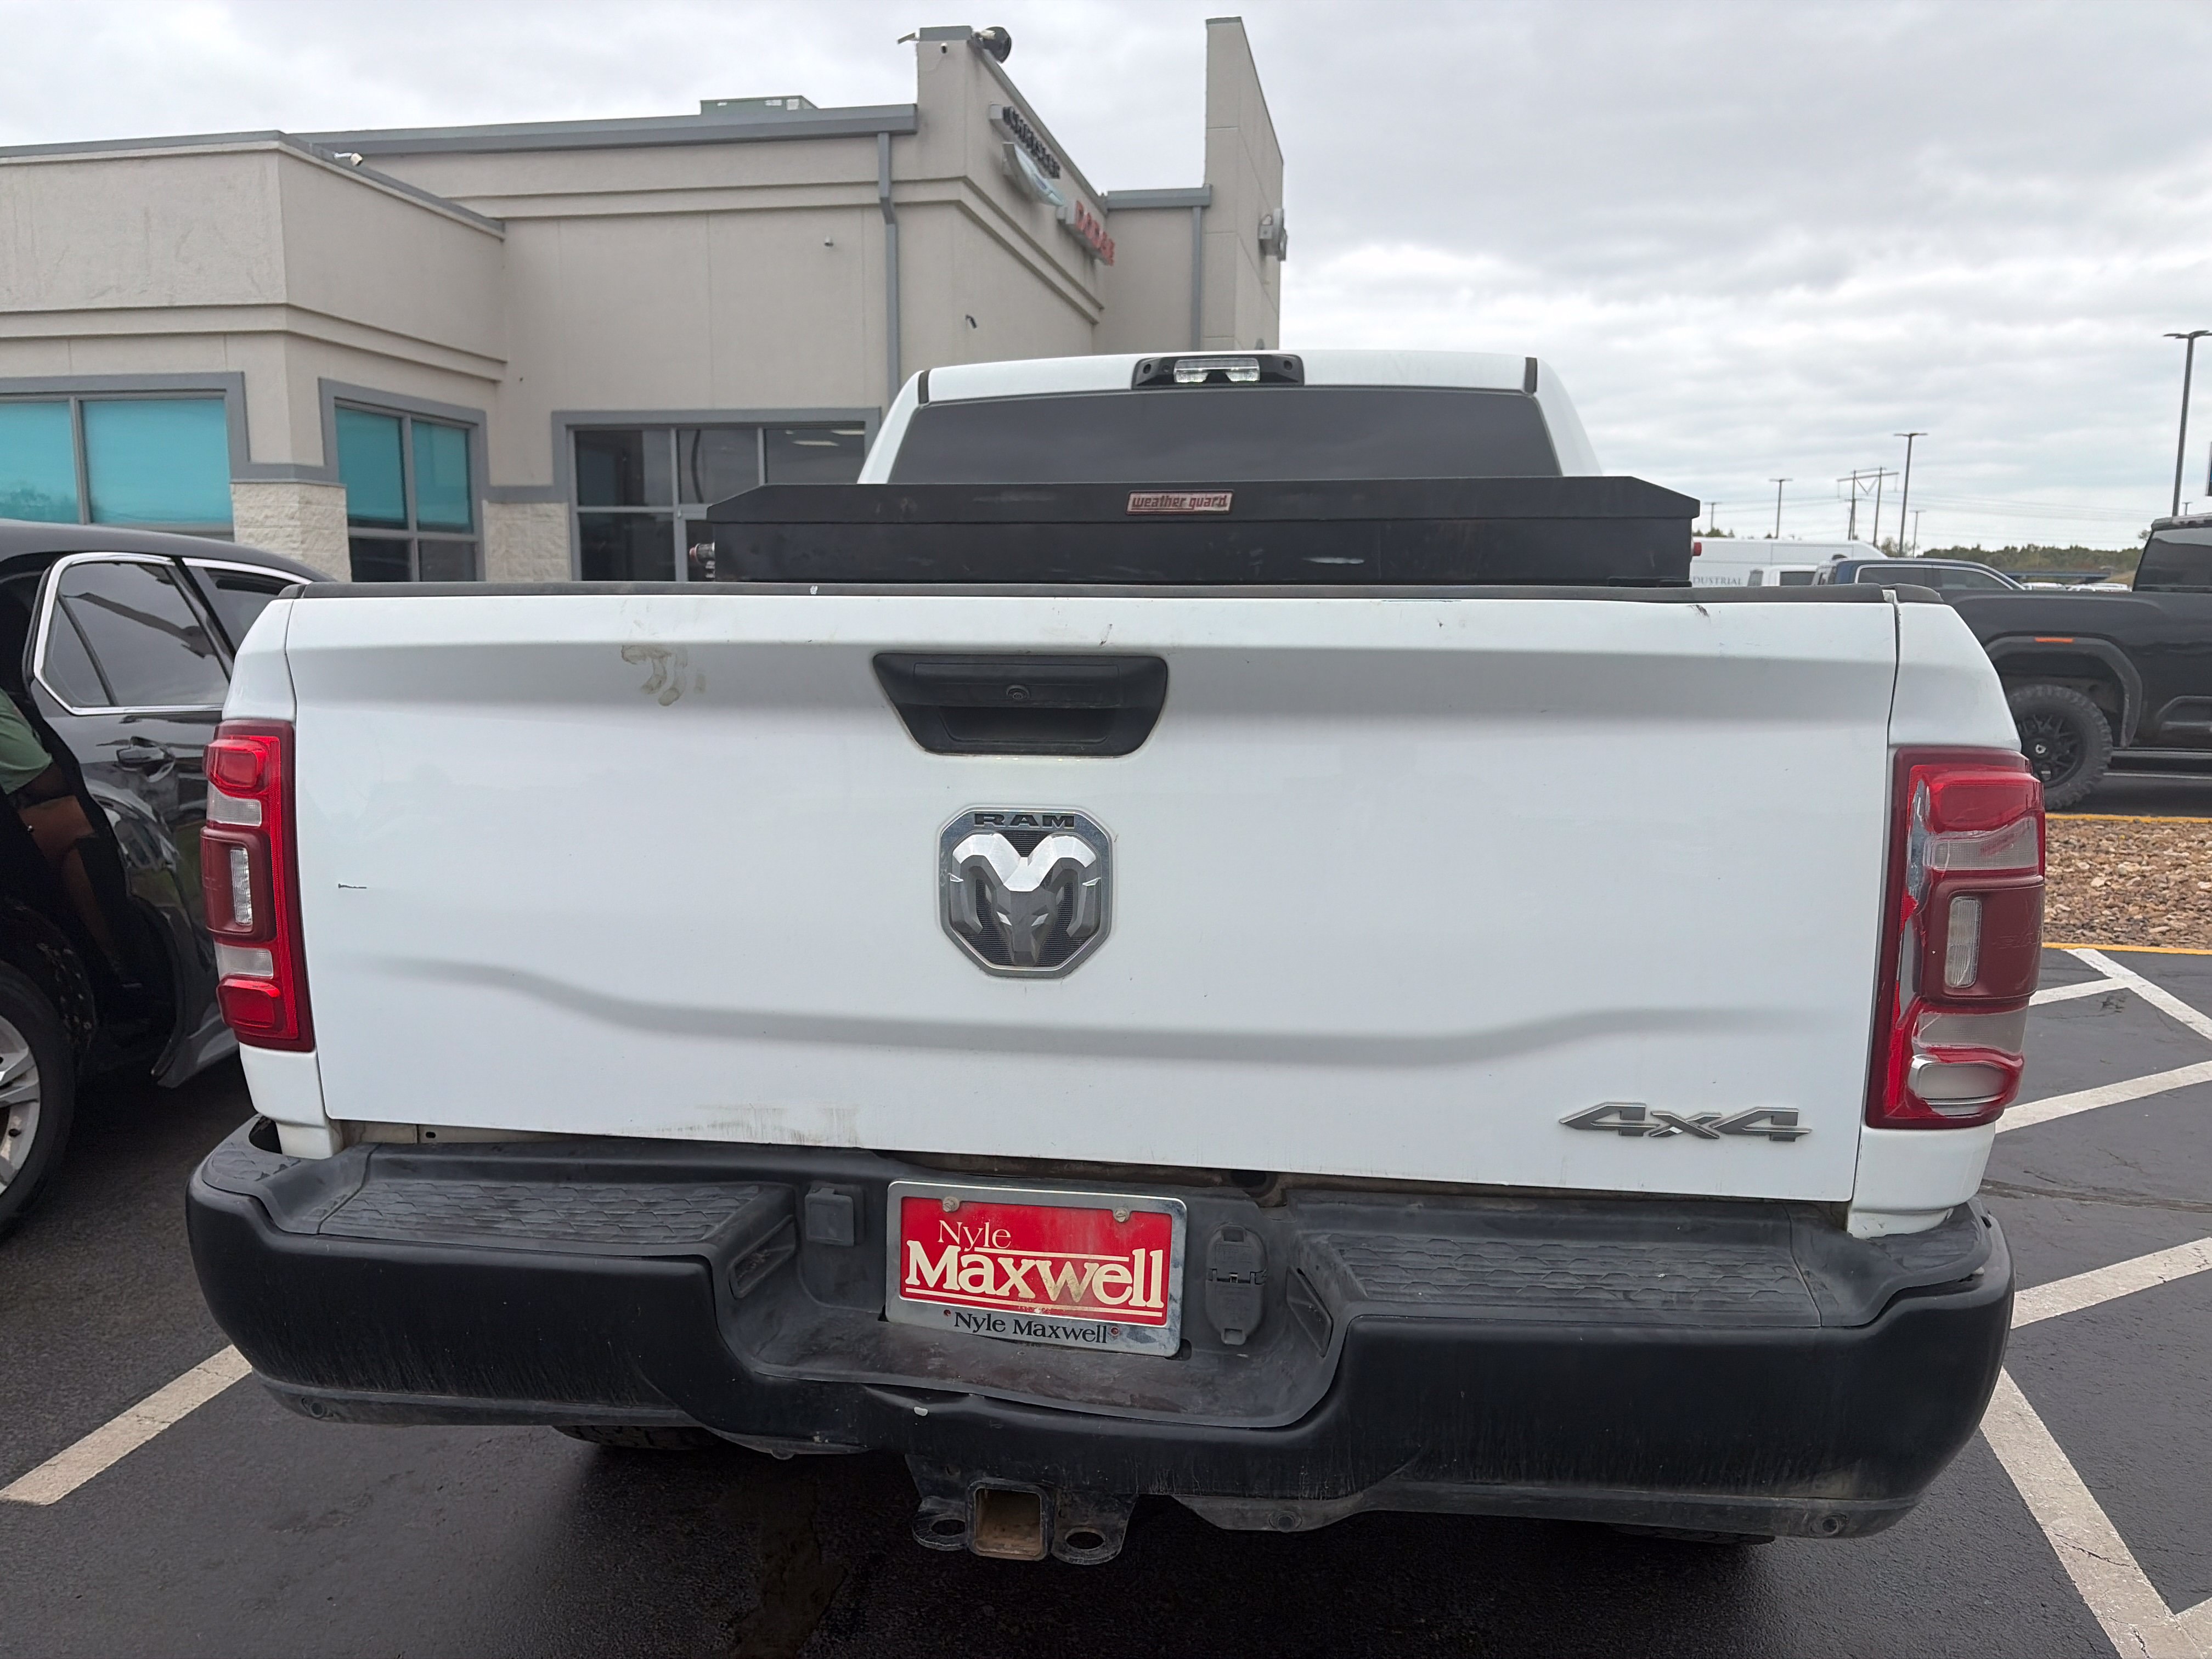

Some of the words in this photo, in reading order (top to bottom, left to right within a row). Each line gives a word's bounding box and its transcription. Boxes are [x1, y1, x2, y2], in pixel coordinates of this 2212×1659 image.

[1132, 495, 1186, 508] weather
[1188, 495, 1228, 510] guard
[1692, 575, 1743, 585] DUSTRIAL
[973, 813, 1075, 830] RAM
[938, 1219, 1012, 1252] Nyle
[905, 1240, 1165, 1308] Maxwell
[953, 1311, 1006, 1333] Nyle
[1013, 1318, 1107, 1344] Maxwell
